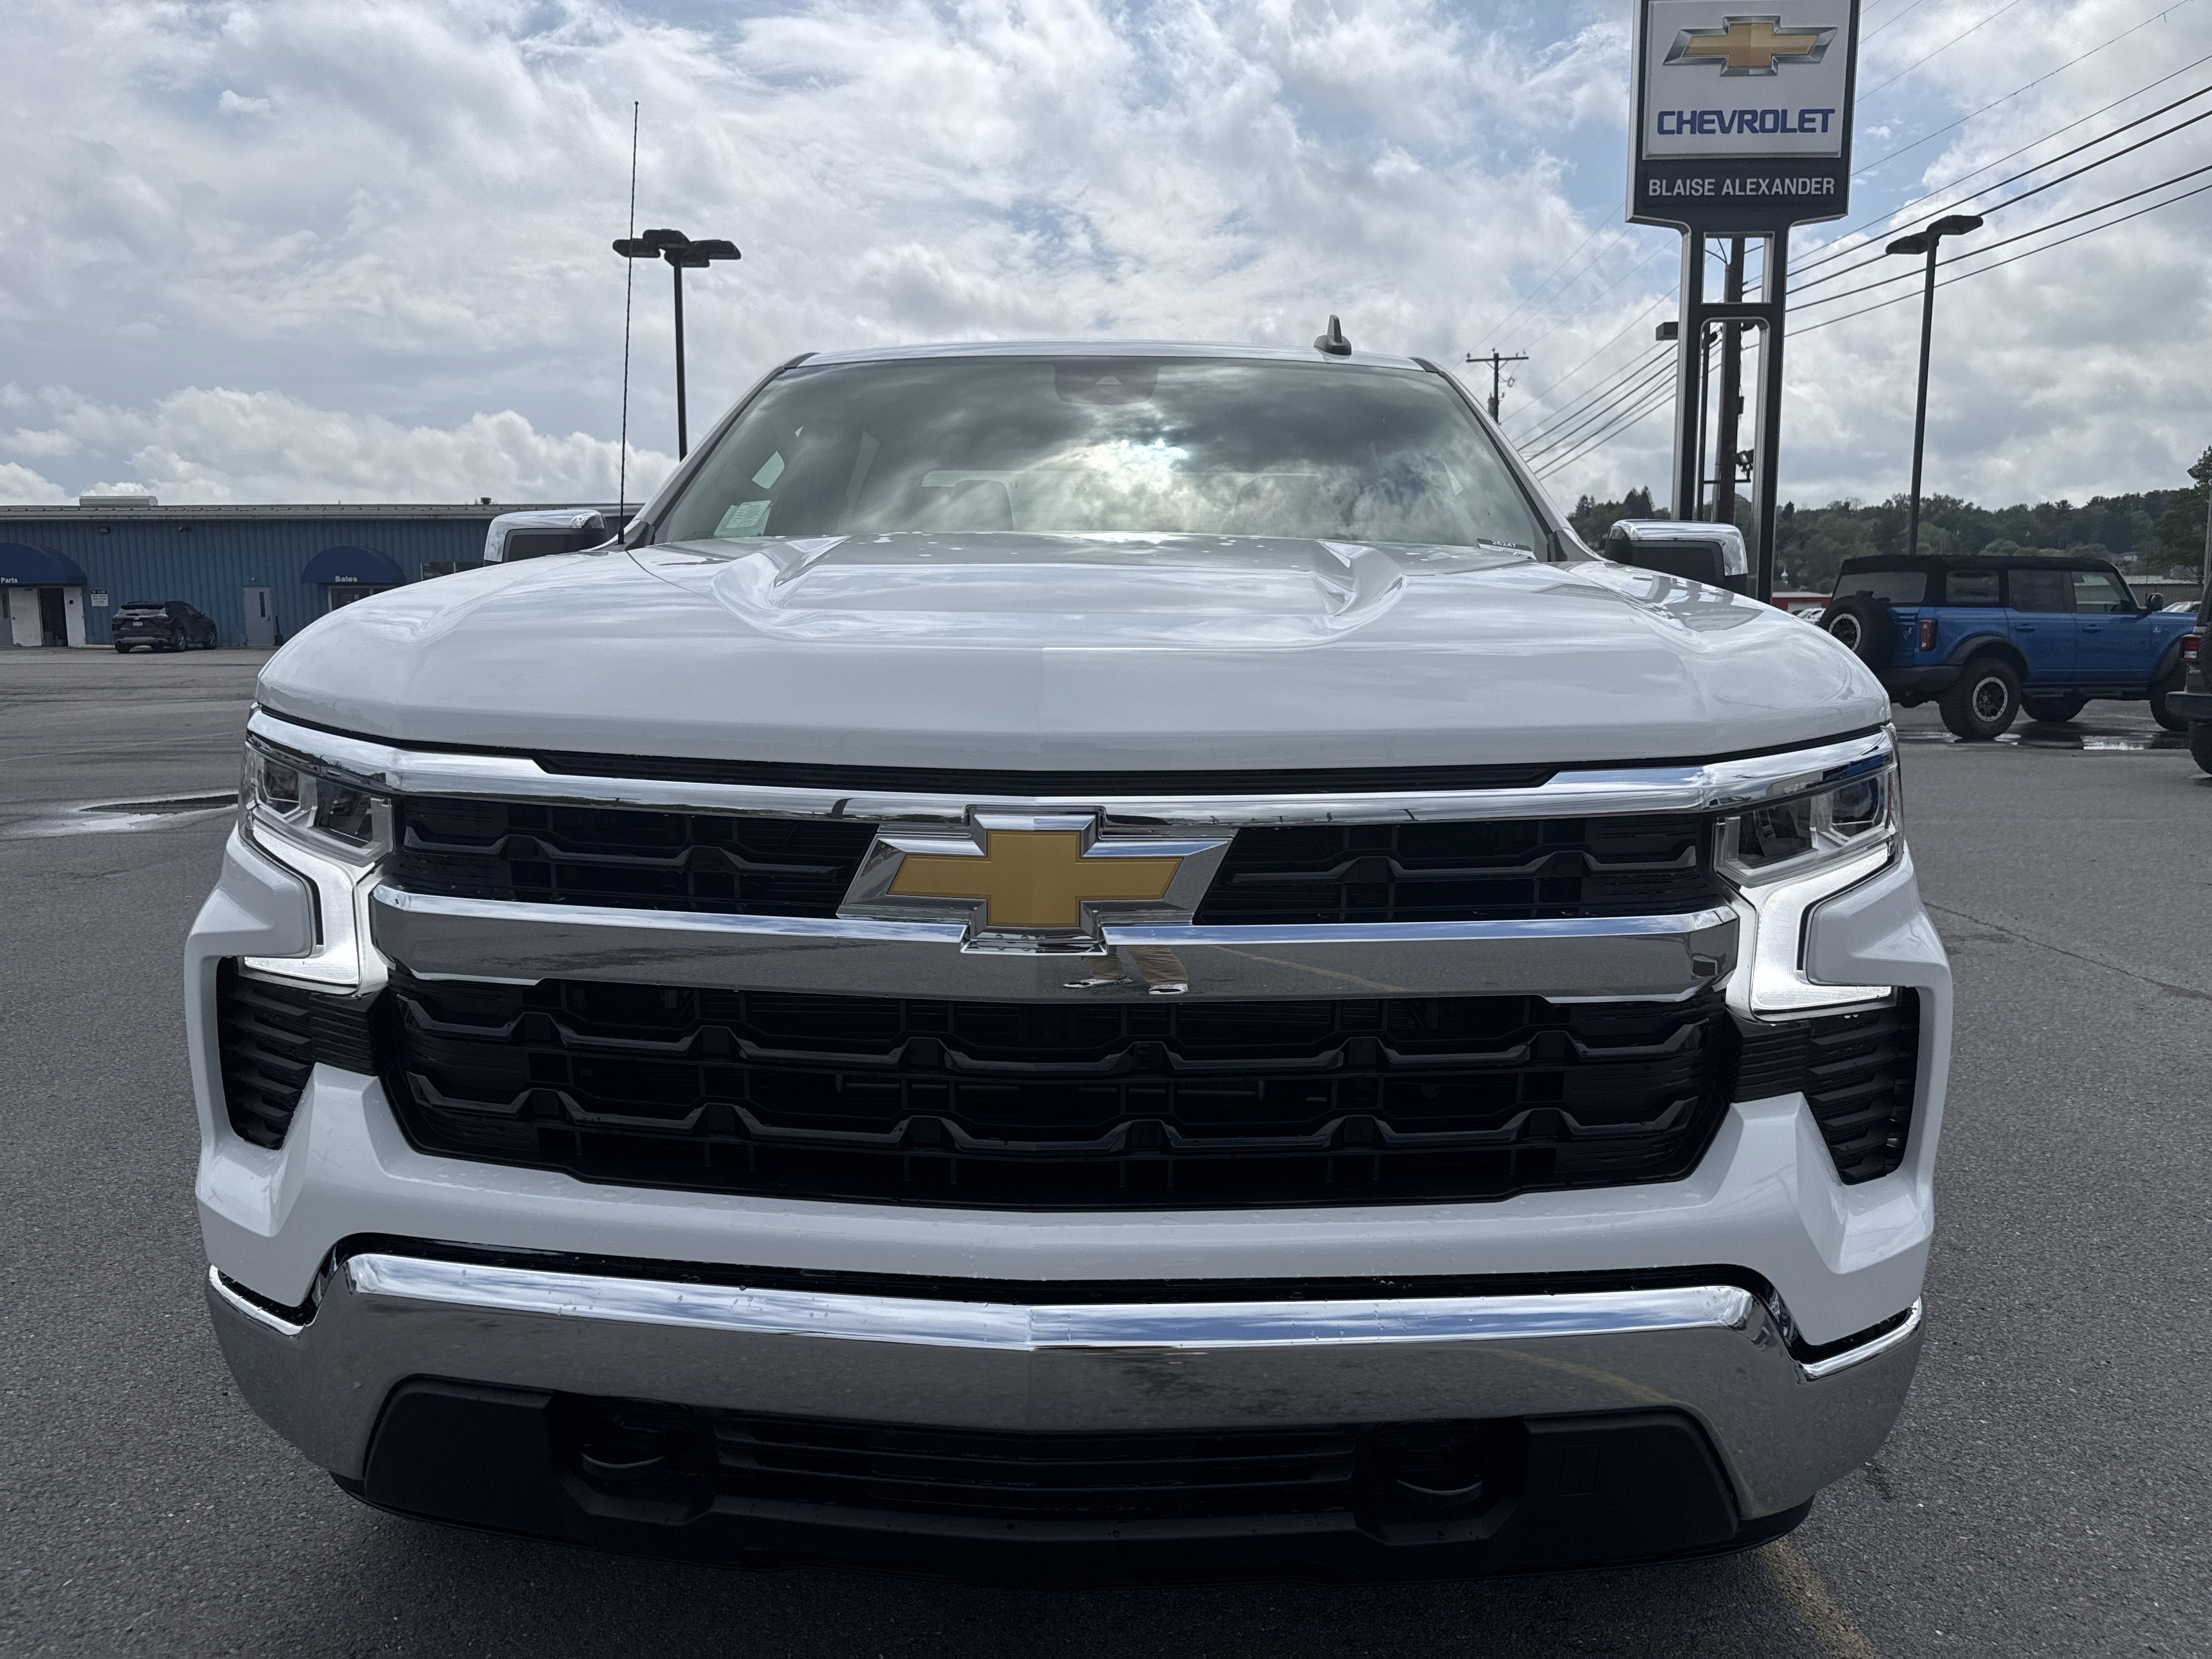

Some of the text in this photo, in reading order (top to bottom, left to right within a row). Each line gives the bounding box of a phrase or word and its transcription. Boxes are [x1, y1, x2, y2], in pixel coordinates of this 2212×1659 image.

[1657, 109, 1835, 134] CHEVROLET
[1649, 178, 1835, 196] BLAISE ALEXANDER
